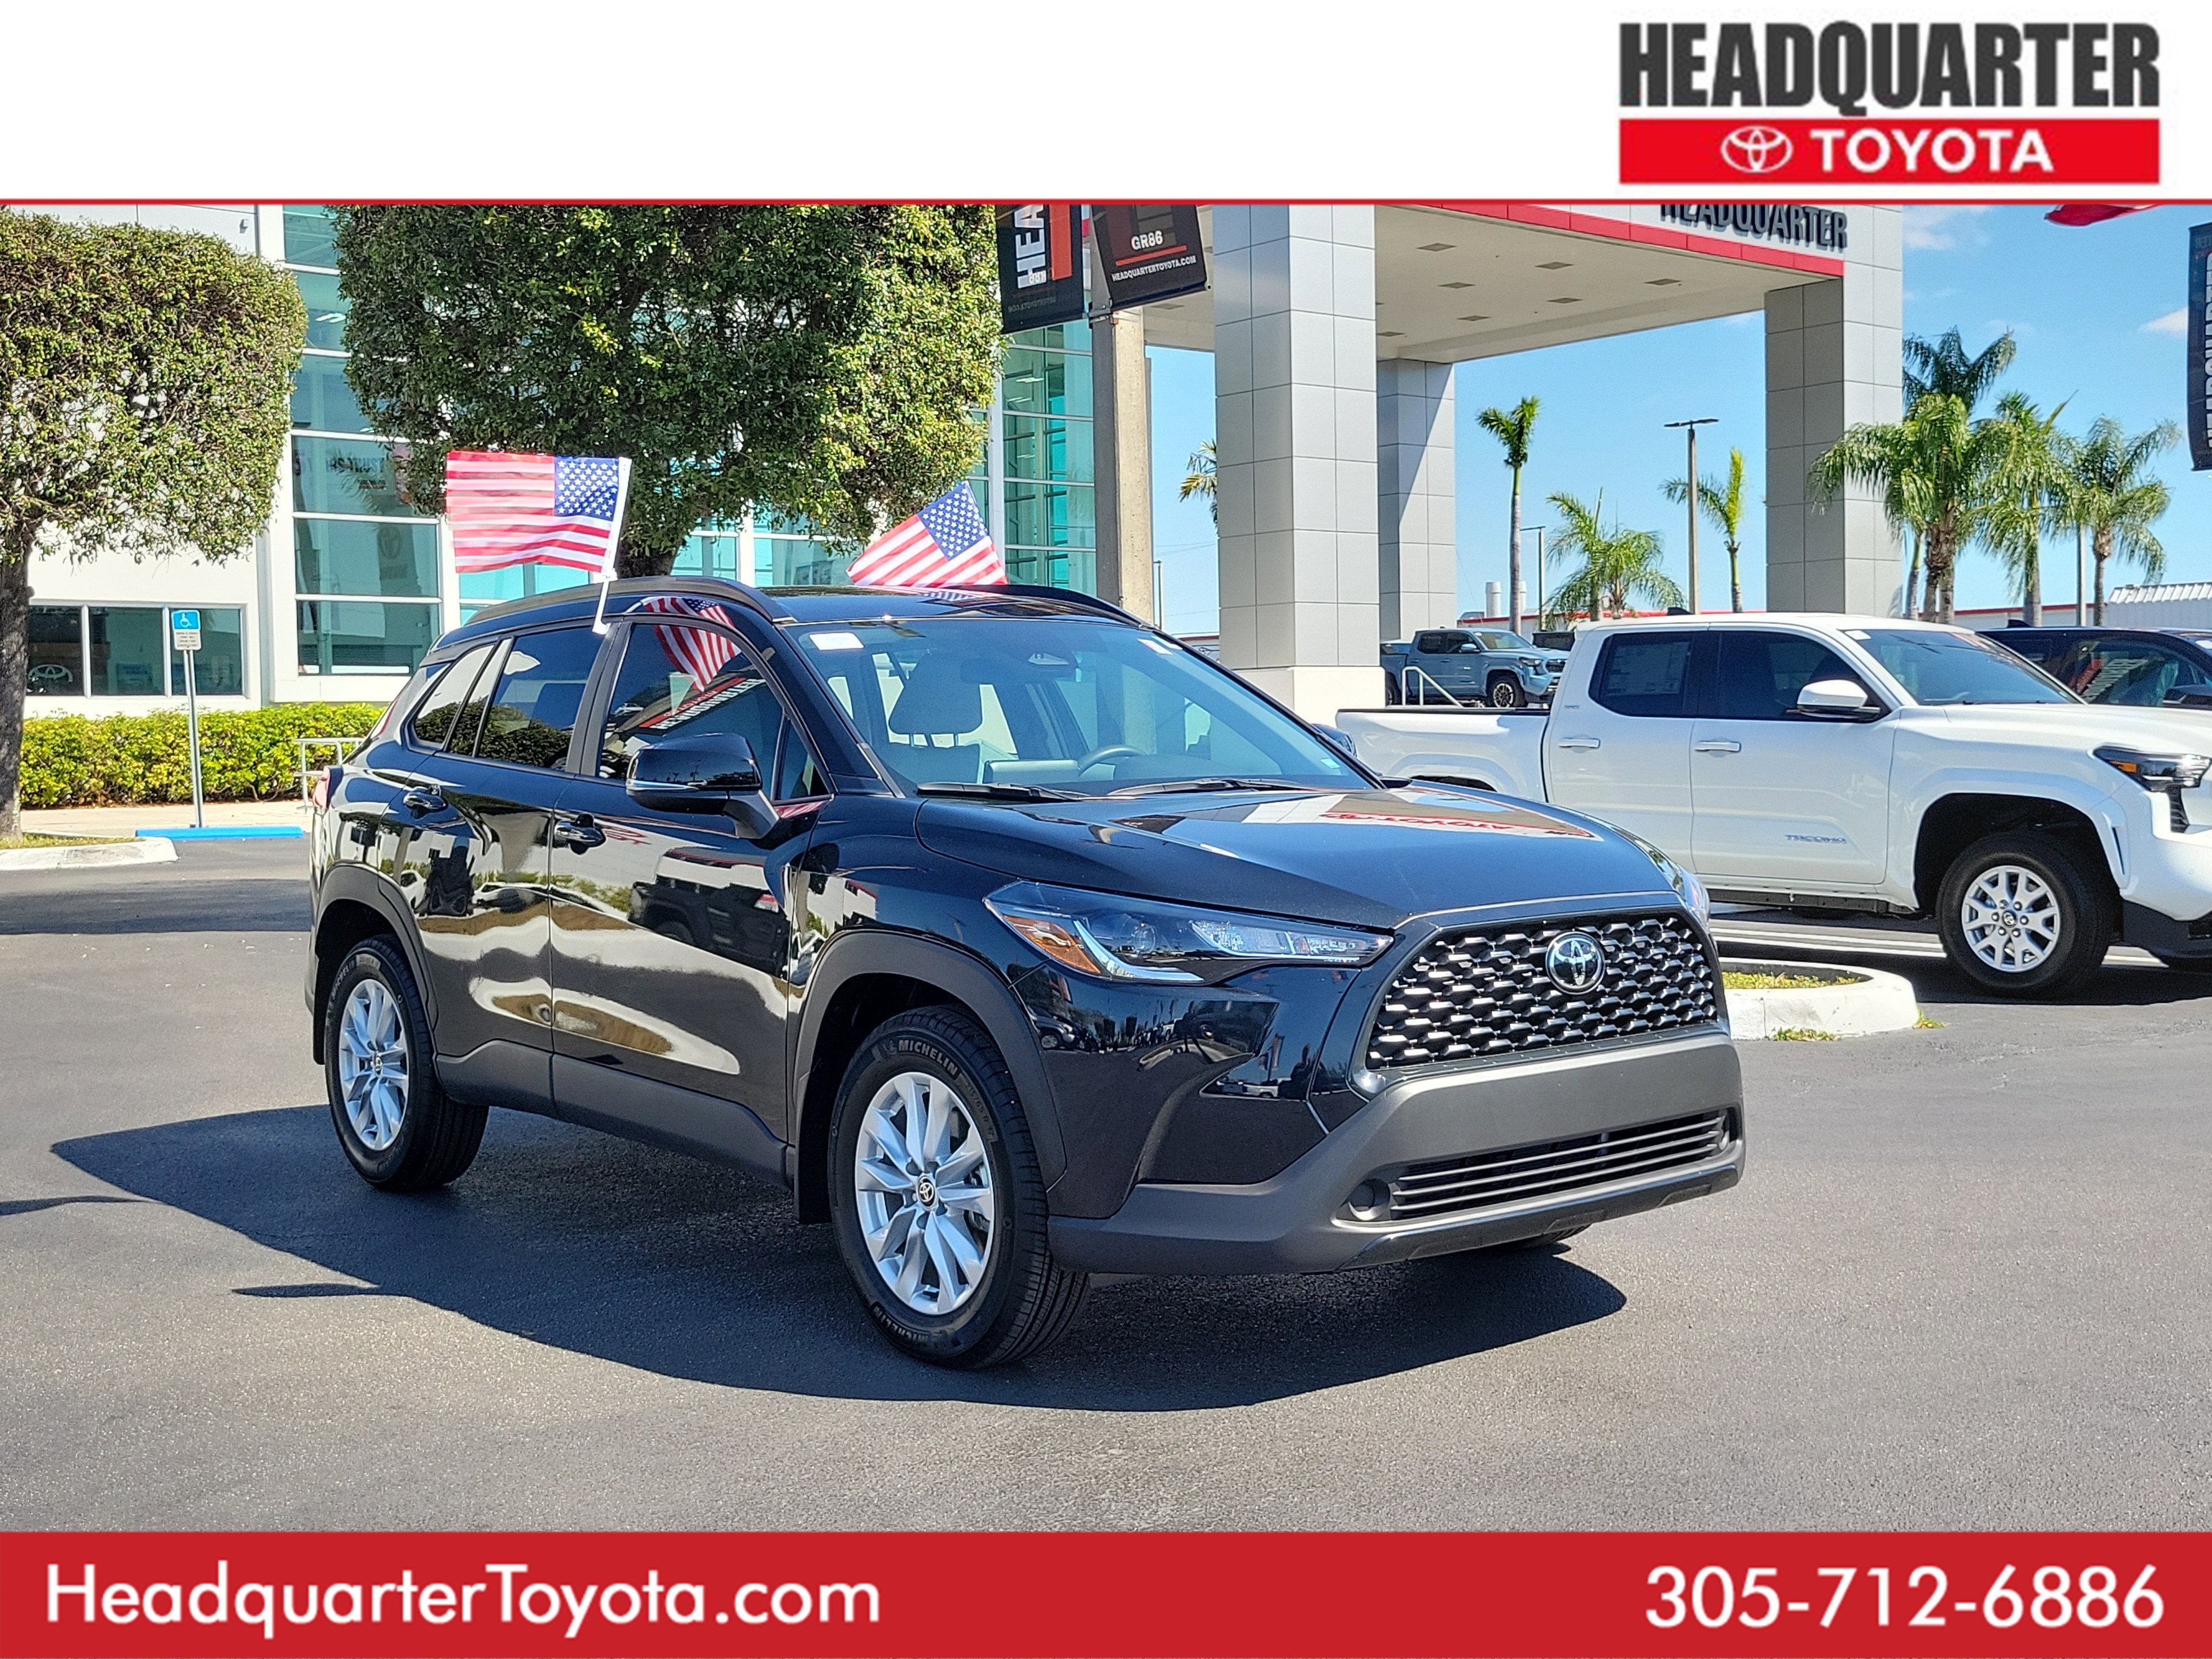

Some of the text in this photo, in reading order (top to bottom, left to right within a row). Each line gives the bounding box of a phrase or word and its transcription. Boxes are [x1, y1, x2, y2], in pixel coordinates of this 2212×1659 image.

[1131, 230, 1163, 250] GR86
[1111, 255, 1197, 282] HEADQUARTERTOYOTA.COM
[899, 1040, 958, 1075] MICHELIN
